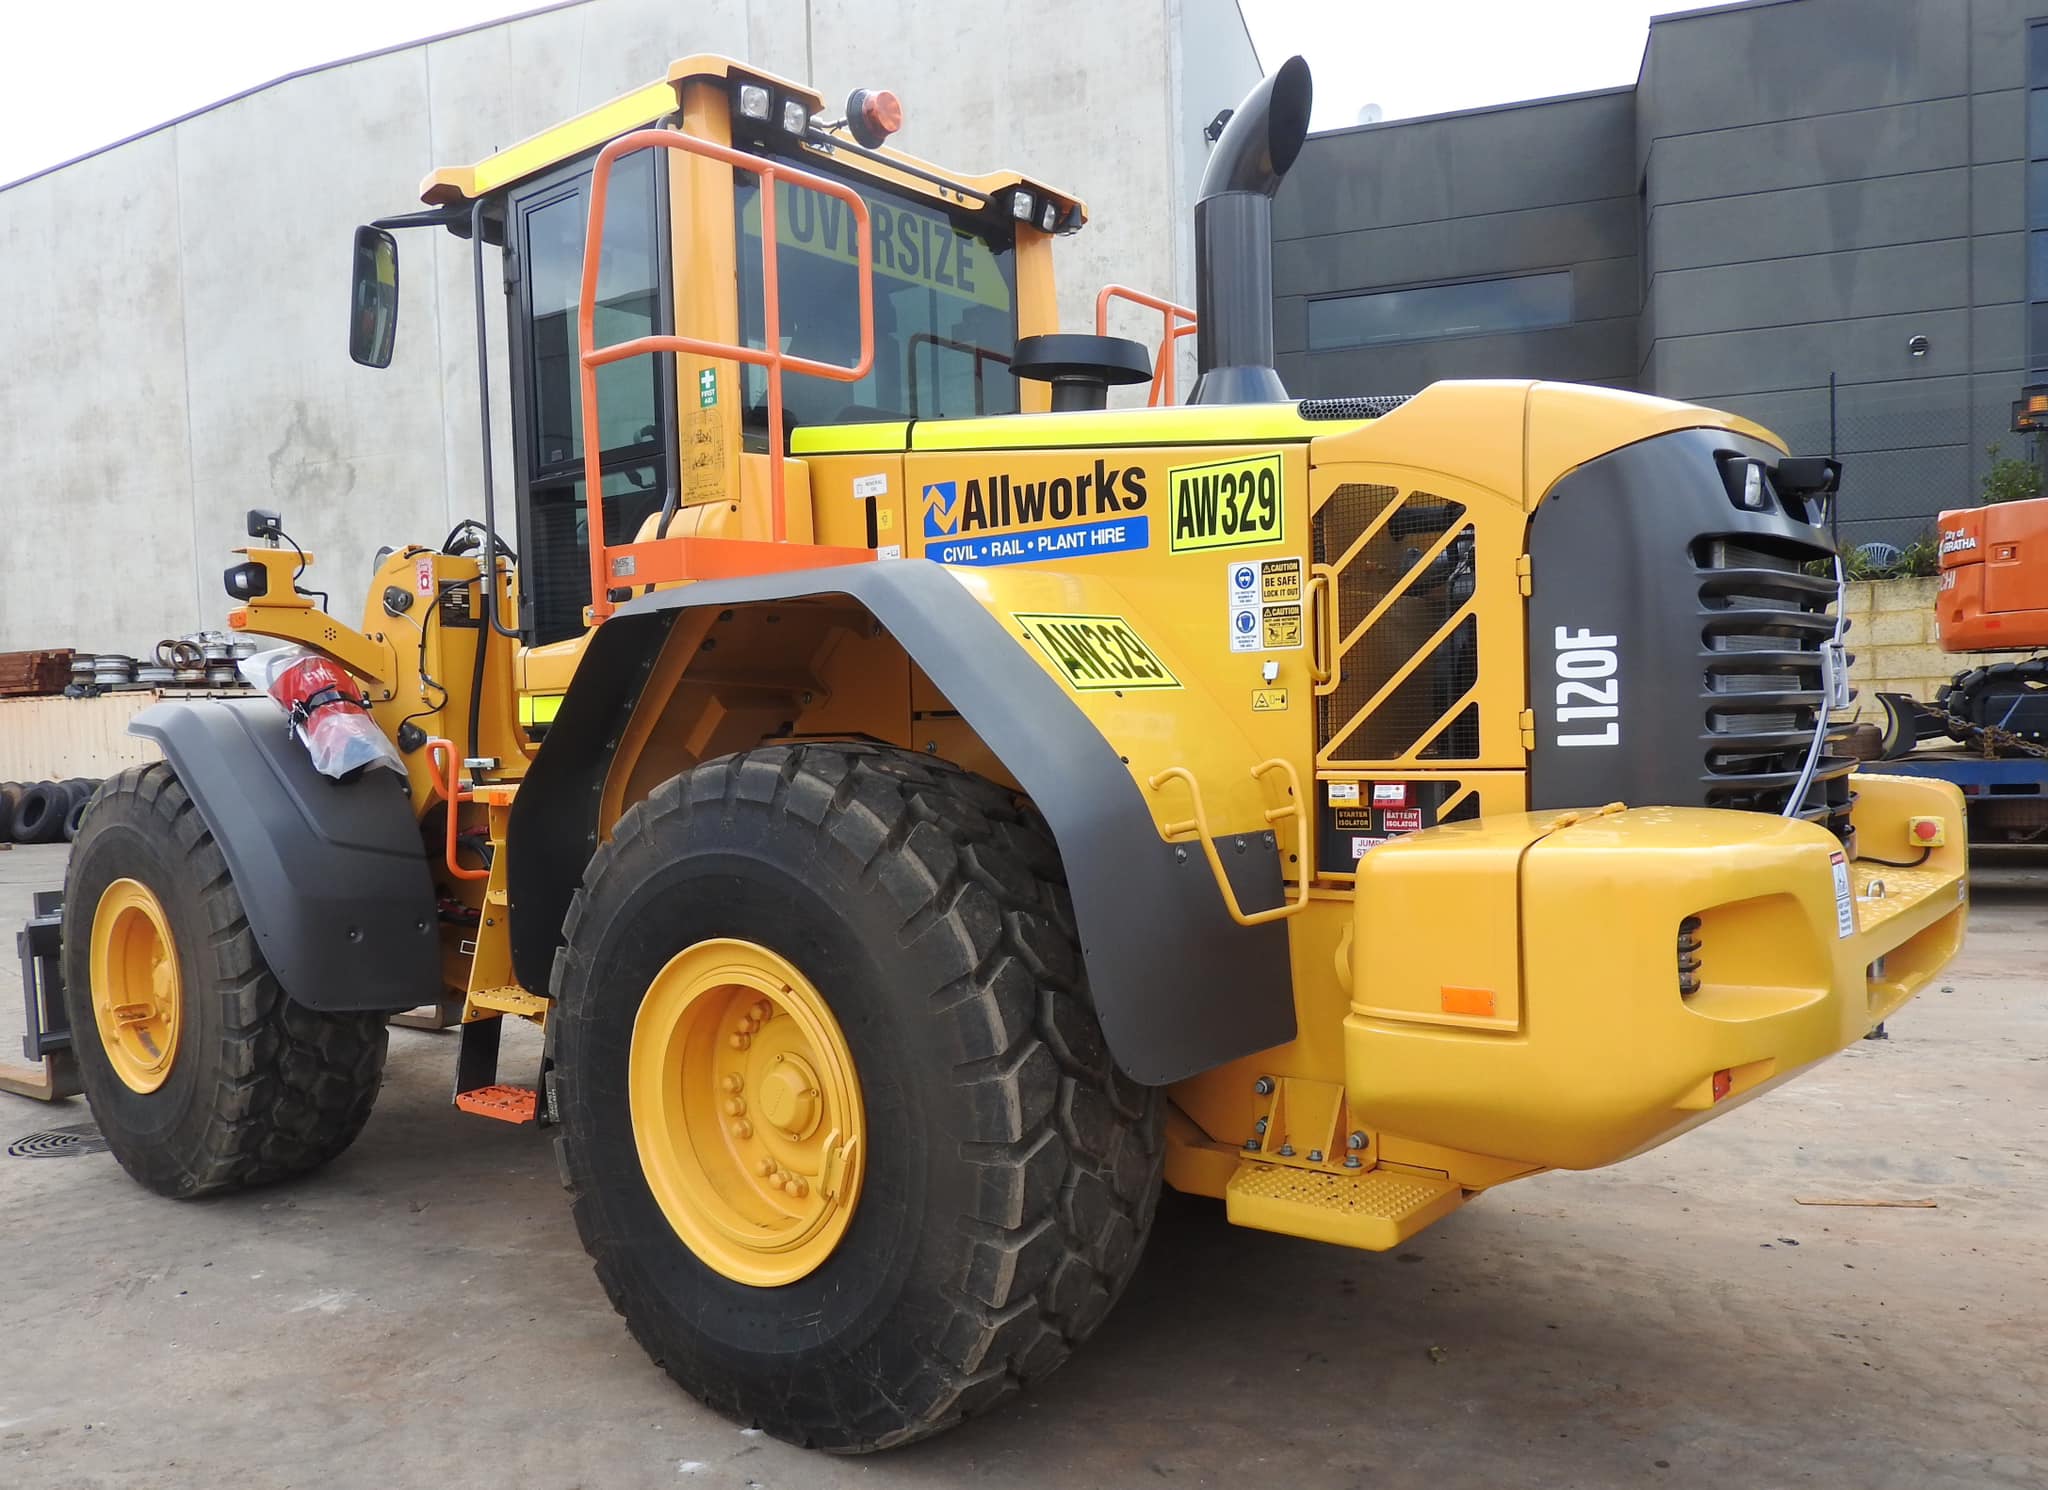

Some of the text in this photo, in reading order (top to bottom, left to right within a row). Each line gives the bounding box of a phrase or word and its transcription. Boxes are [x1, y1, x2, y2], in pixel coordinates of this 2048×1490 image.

[961, 459, 1147, 532] Allworks
[1176, 467, 1276, 540] AW329
[943, 526, 1126, 563] CIVIL RAIL PLANT HIRE
[1271, 562, 1298, 572] CAUTION
[1264, 575, 1297, 587] BE SAFE
[1263, 589, 1278, 598] LOCK
[1280, 588, 1286, 596] IT
[1287, 587, 1298, 596] OUT
[1271, 607, 1299, 616] CAUTION
[1036, 623, 1164, 680] AW329
[1555, 626, 1619, 747] L120F
[1386, 811, 1418, 819] BATTERY
[1386, 820, 1418, 828] ISOLATOR
